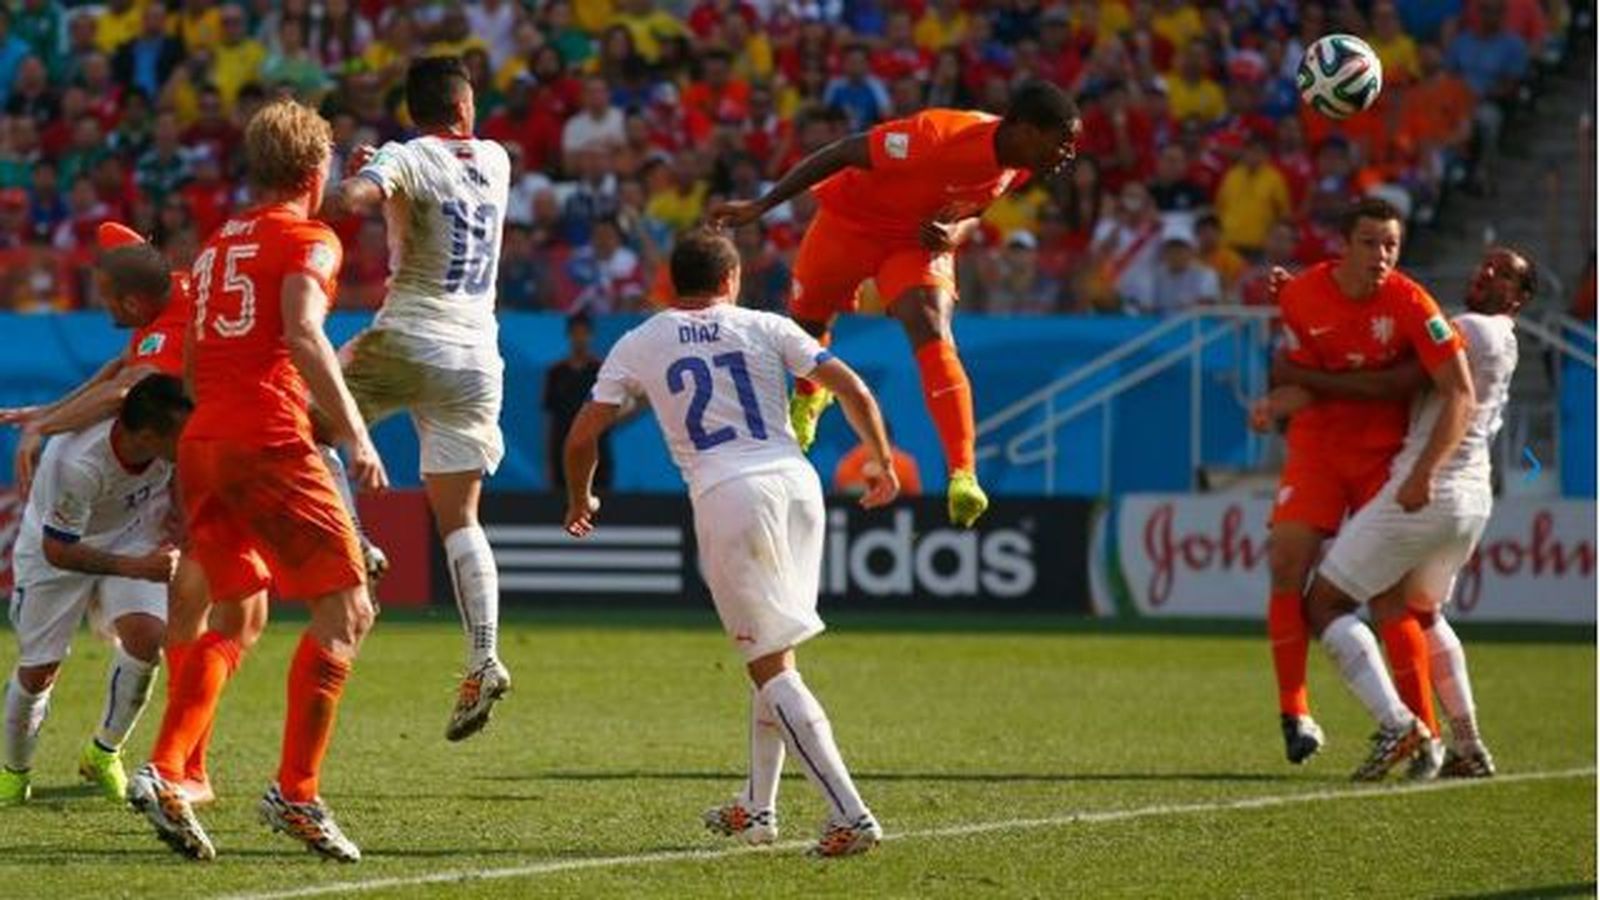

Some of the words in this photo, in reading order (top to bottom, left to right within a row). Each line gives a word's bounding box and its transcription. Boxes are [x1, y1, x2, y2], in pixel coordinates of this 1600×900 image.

[191, 247, 259, 340] 15
[666, 350, 768, 451] 21
[820, 508, 1036, 597] idas
